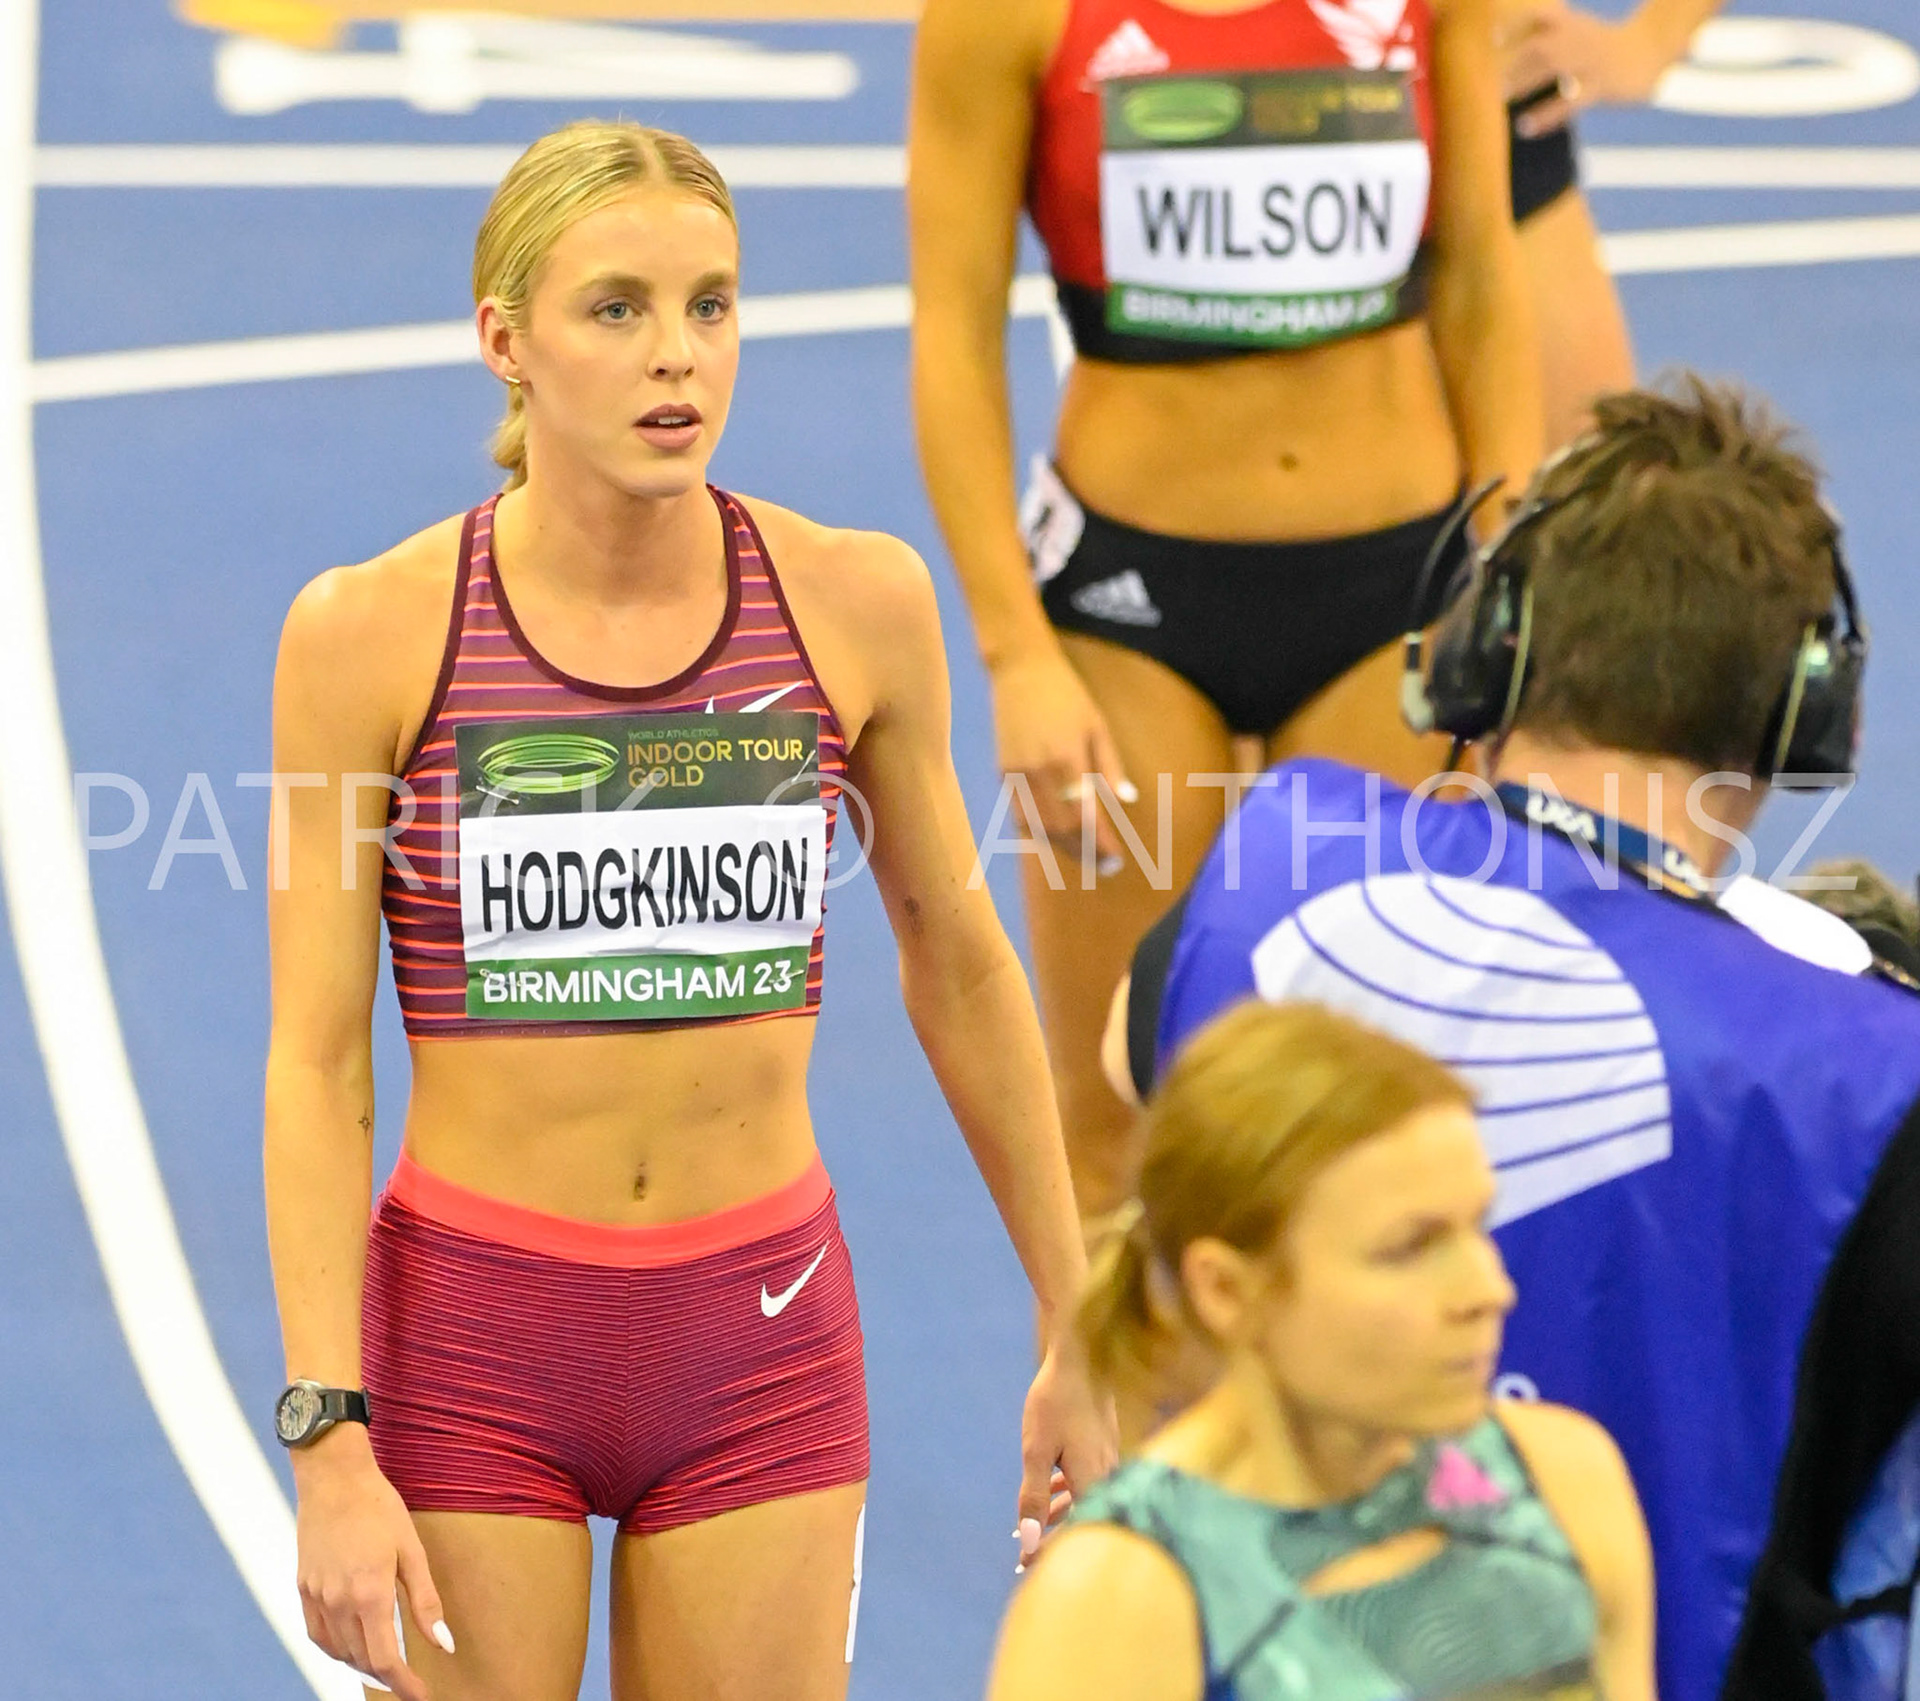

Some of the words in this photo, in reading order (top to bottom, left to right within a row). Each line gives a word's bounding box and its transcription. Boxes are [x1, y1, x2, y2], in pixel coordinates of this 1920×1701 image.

[1135, 179, 1393, 259] WILSON
[628, 729, 665, 740] WORLD
[666, 727, 720, 739] ATHLETICS
[627, 739, 733, 766] INDOOR
[738, 738, 804, 761] TOUR
[628, 764, 705, 789] GOLD
[481, 837, 809, 934] HODGKINSON
[484, 964, 745, 1004] BIRMINGHAM
[752, 959, 793, 997] 23
